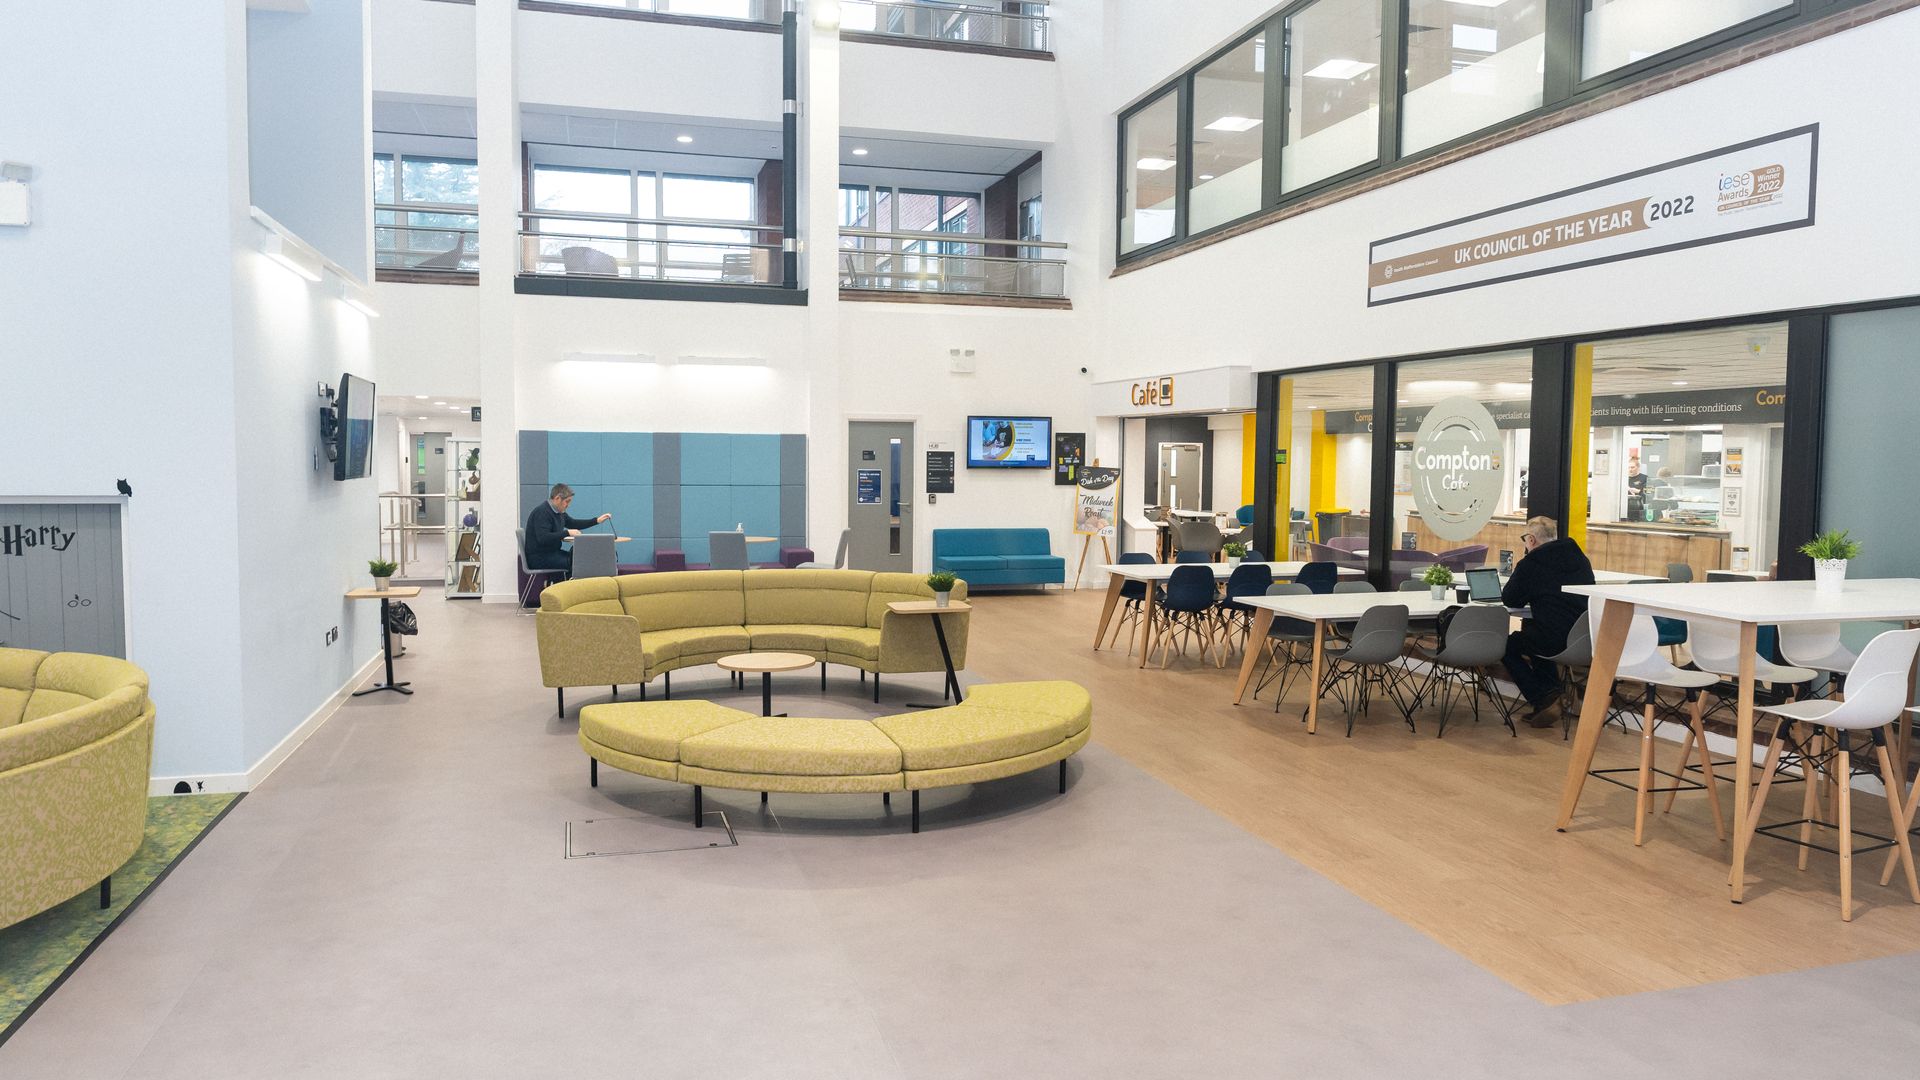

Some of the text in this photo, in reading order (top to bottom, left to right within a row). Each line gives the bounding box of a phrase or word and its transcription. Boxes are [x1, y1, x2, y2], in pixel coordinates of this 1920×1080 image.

[1718, 173, 1750, 191] iese
[1757, 173, 1780, 182] Winner
[1757, 180, 1780, 193] 2022
[1717, 188, 1749, 202] Awards
[1454, 247, 1472, 264] UK
[1473, 235, 1529, 260] COUNCIL
[1532, 228, 1551, 247] OF
[1555, 220, 1585, 242] THE
[1588, 209, 1633, 235] YEAR
[1650, 195, 1695, 221] 2022
[1131, 381, 1157, 406] Café
[1496, 411, 1523, 421] specialist
[1591, 402, 1742, 417] ients living with life limiting conditions
[1415, 445, 1491, 480] Compton
[1081, 477, 1093, 486] Dish
[1101, 475, 1114, 484] Day
[1080, 494, 1114, 507] Midweek
[1084, 507, 1108, 519] Roast
[0, 524, 76, 557] Harry
